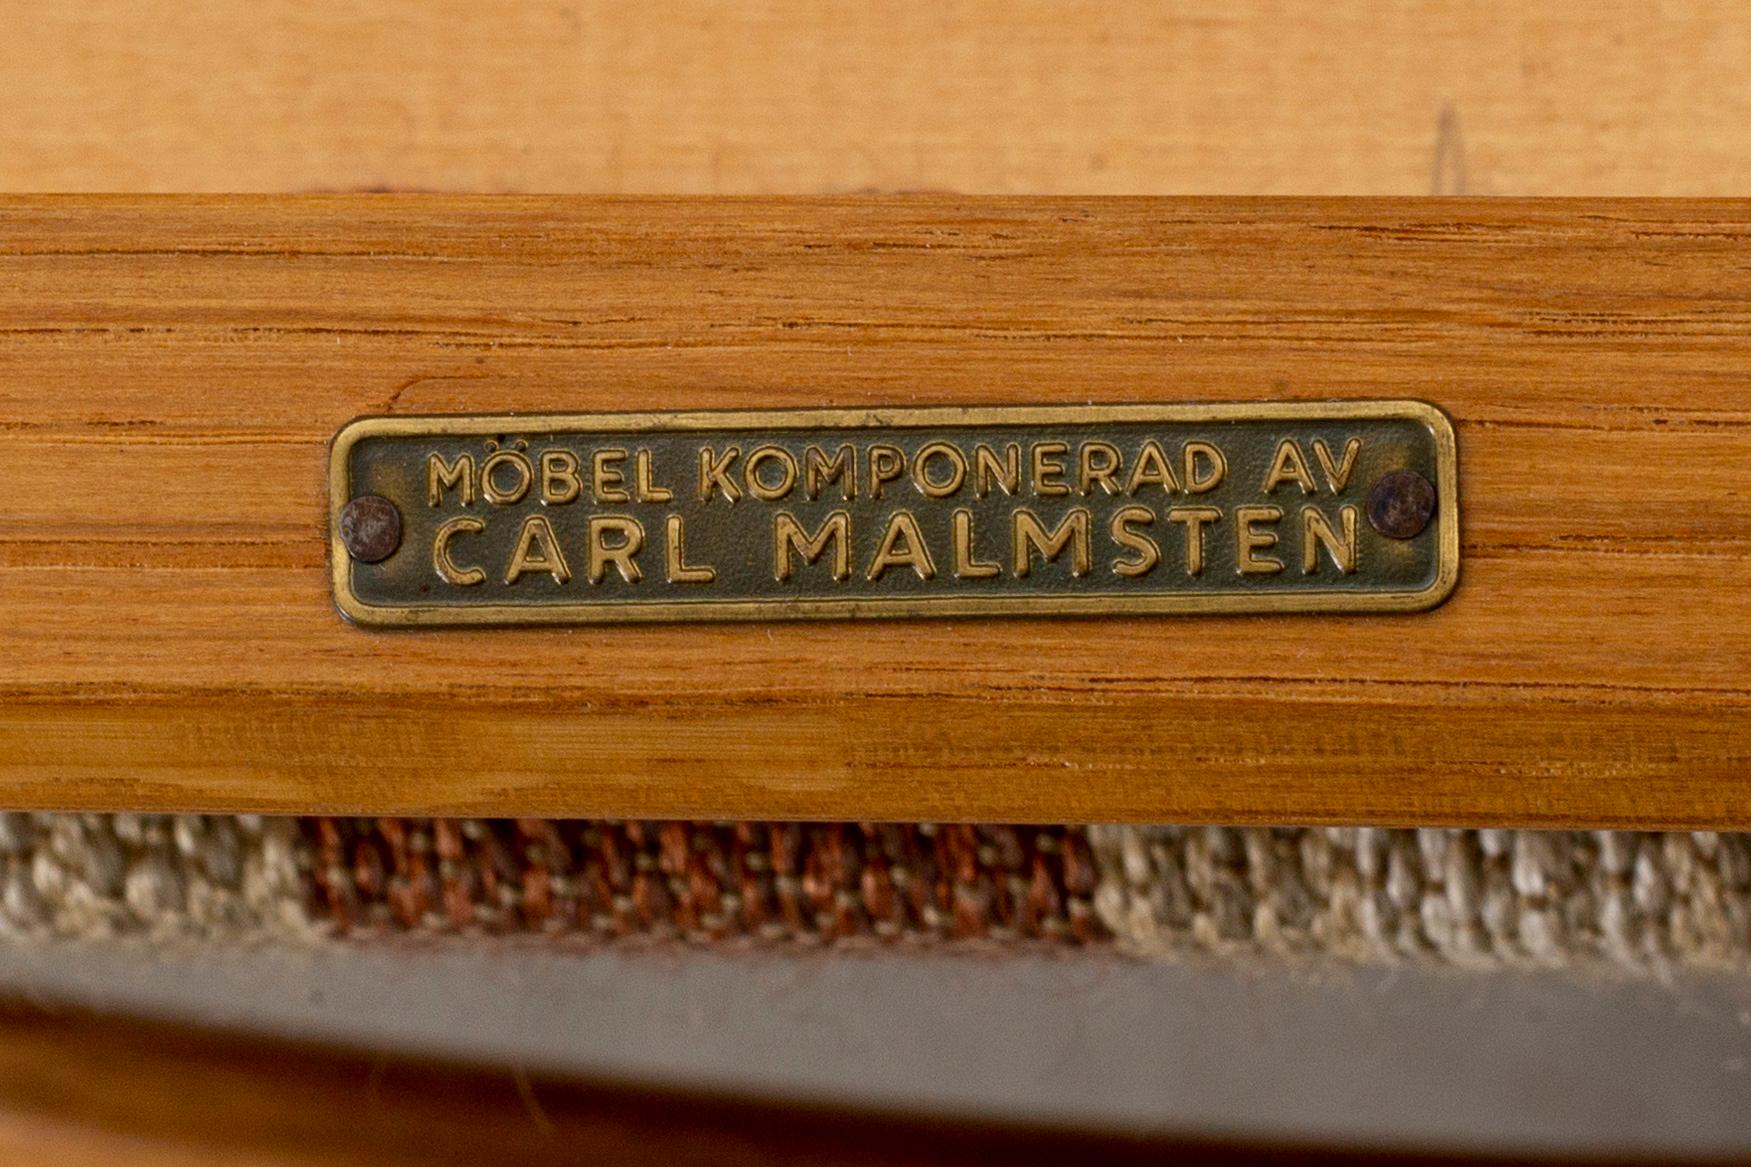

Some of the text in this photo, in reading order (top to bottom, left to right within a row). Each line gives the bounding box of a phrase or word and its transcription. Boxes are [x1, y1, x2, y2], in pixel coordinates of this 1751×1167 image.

[427, 436, 1361, 508] MÖBEL KOMPONERAD AV
[432, 506, 1359, 587] CARL MALMSTEN
